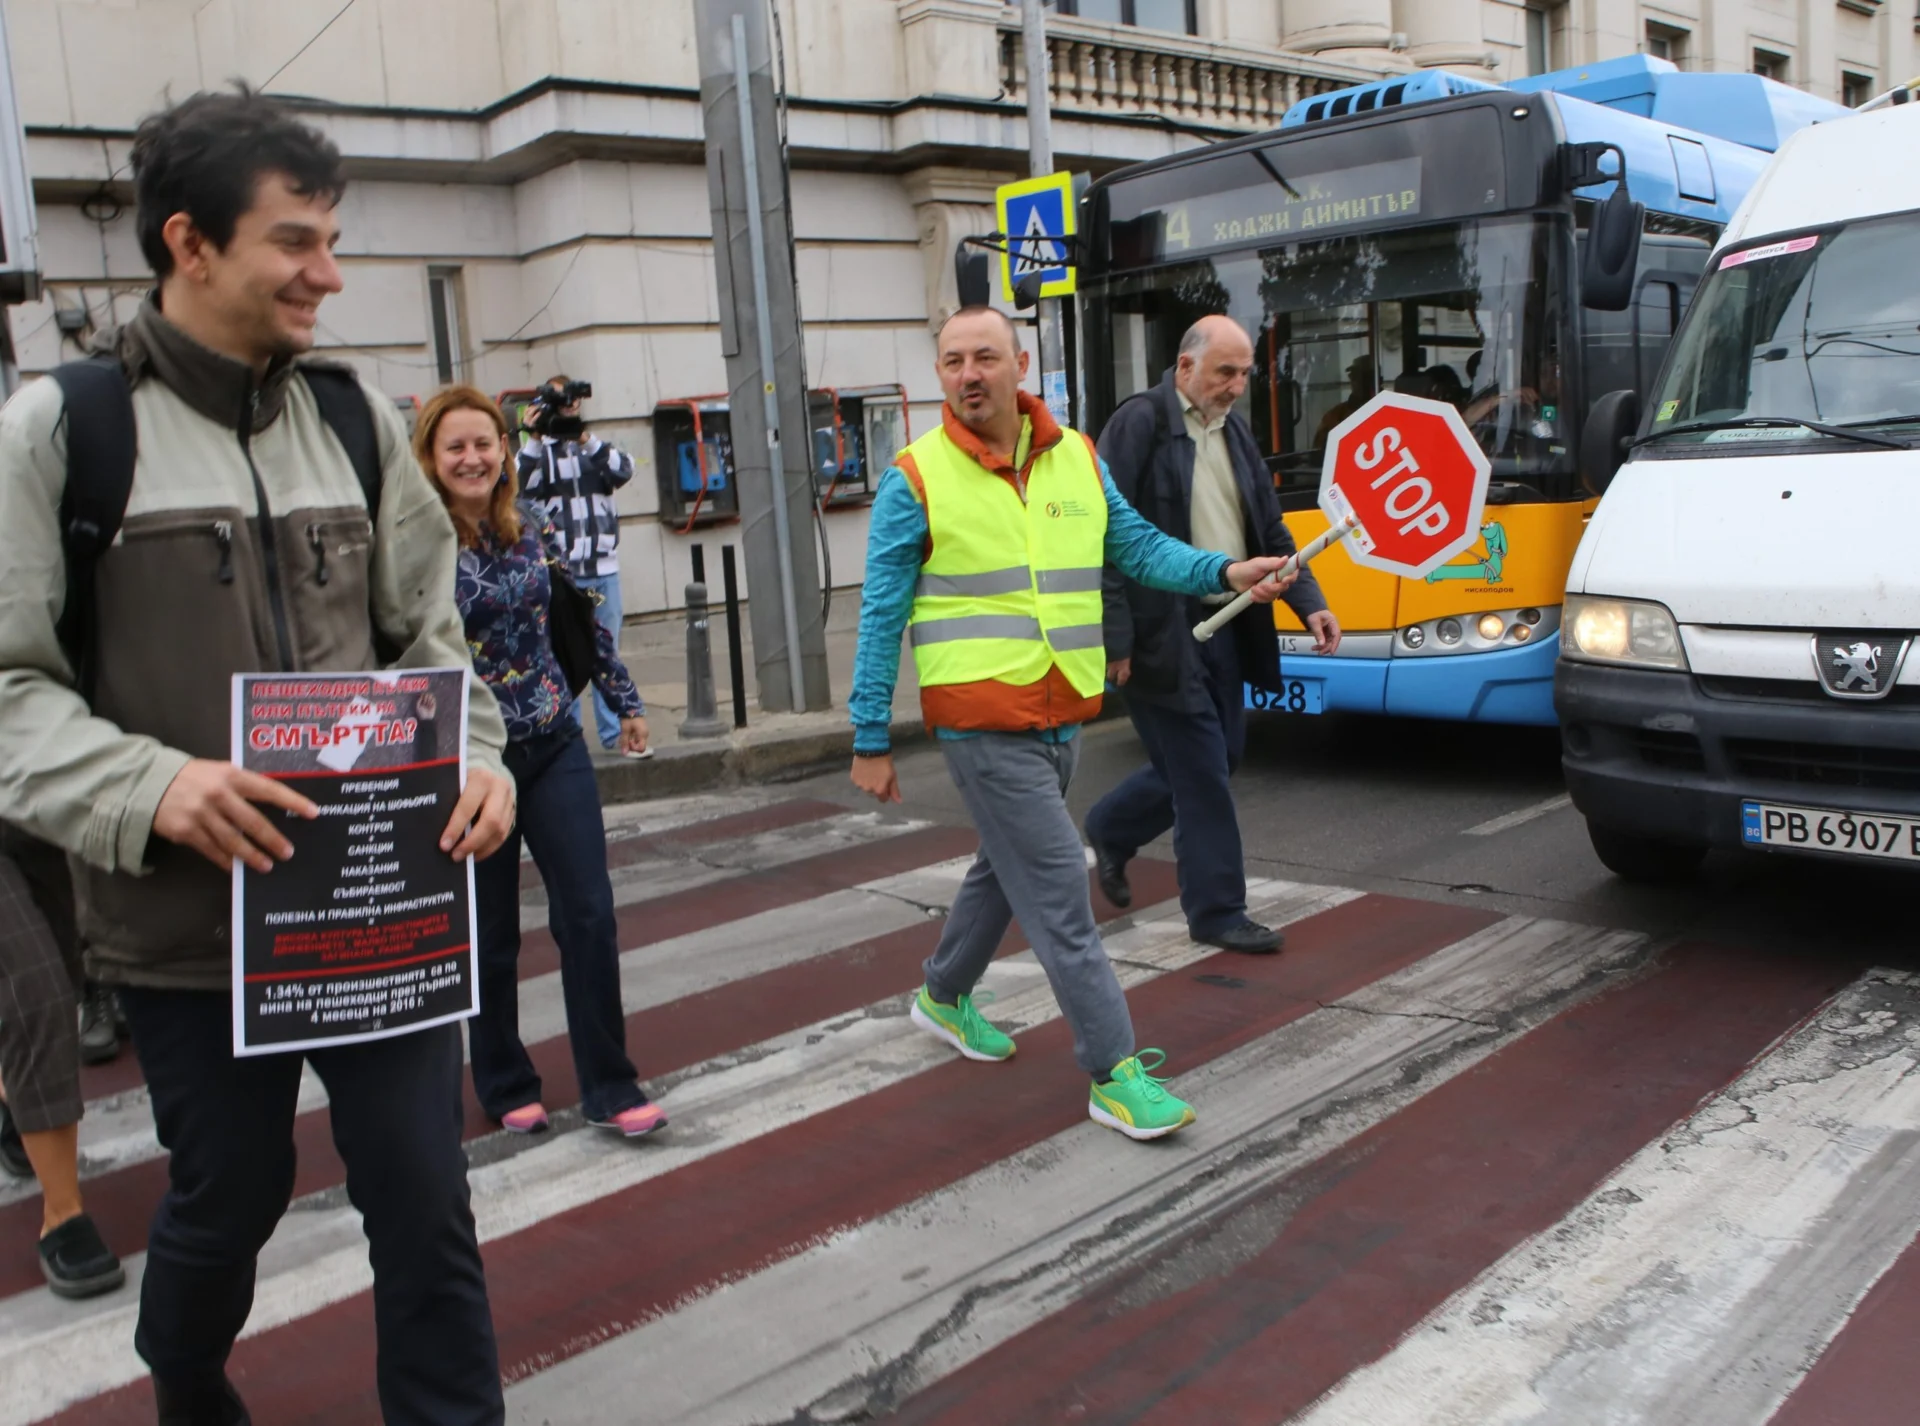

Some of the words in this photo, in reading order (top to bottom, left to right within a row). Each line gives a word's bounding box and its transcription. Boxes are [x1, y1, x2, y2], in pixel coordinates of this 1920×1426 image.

[1166, 206, 1191, 249] 4
[1214, 210, 1290, 241] ХАДЖИ
[1301, 189, 1416, 229] ДИМИТЪР
[1354, 426, 1450, 537] STOP
[252, 680, 370, 699] ПЕШЕХОДНИ
[252, 703, 293, 719] ИЛИ
[297, 701, 371, 719] ПЪТЕКИ
[376, 700, 397, 715] НА
[251, 717, 418, 750] СМЪРТТА?
[341, 778, 400, 794] ПРЕВЕНЦИЯ
[286, 802, 371, 819] КИФИКАЦИЯ
[372, 800, 386, 813] НА
[348, 820, 394, 836] КОНТРОЛ
[1746, 827, 1760, 837] BG
[1765, 810, 1809, 843] PB
[347, 841, 394, 857] САНКЦИИ
[341, 861, 400, 878] НАКАЗАНИЯ
[333, 880, 406, 900] СЪБИРАЕМОСТ
[265, 910, 316, 926] ПОЛЕЗНА
[317, 909, 326, 921] И
[327, 904, 382, 921] ПРАВИЛНА
[383, 891, 455, 914] ИНФРАСТРУКТУРА
[308, 983, 323, 996] от
[326, 968, 425, 996] произшествията
[430, 964, 442, 978] са
[445, 960, 457, 973] по
[260, 1000, 292, 1016] вина
[296, 998, 312, 1012] на
[316, 989, 388, 1010] пешеходци
[391, 984, 416, 1002] през
[418, 973, 462, 993] първите
[310, 1009, 319, 1024] 4
[322, 1006, 369, 1023] месеца
[372, 1003, 387, 1017] на
